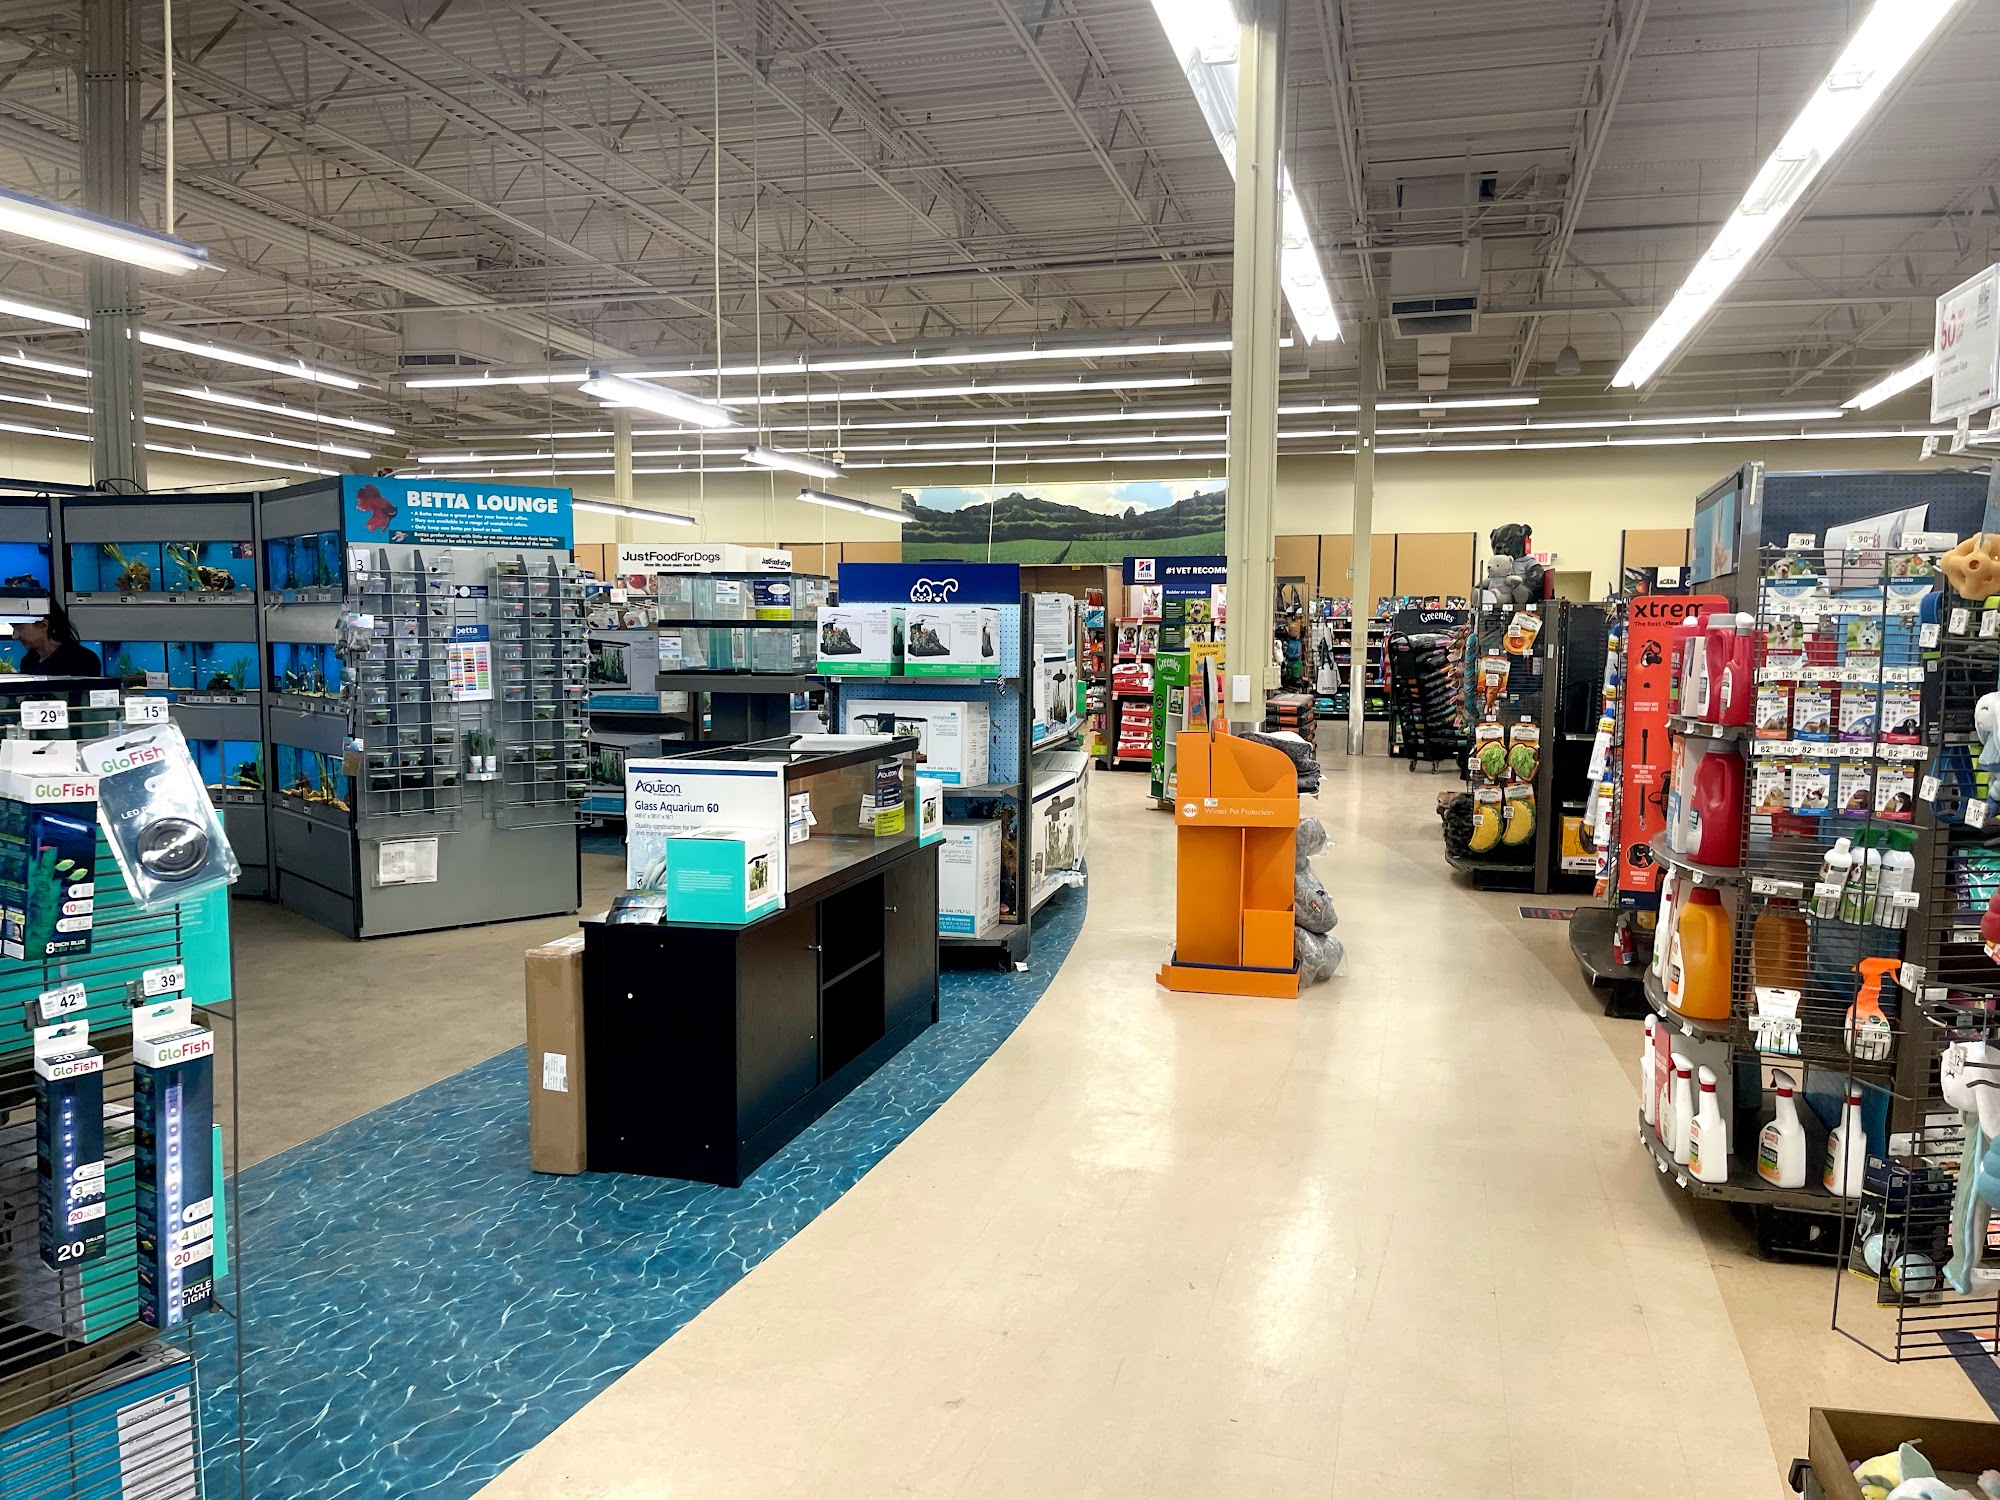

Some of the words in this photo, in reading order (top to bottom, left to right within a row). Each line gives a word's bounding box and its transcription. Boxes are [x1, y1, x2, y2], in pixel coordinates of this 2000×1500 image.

[406, 490, 470, 509] BETTA
[476, 494, 558, 514] LOUNGE
[622, 552, 720, 563] JustFoodForDogs
[357, 560, 364, 570] 3
[1420, 610, 1455, 624] Greenies
[1156, 657, 1181, 672] Greenies
[102, 747, 165, 773] GloFish
[35, 783, 95, 797] GloFish
[121, 808, 139, 819] LED
[635, 800, 657, 810] Glass
[660, 802, 704, 813] Aquarium
[707, 803, 719, 812] 60
[65, 904, 76, 913] 10
[46, 942, 55, 954] 8
[158, 1040, 211, 1061] GloFish
[53, 1060, 98, 1077] GloFish
[75, 1187, 83, 1196] 3
[71, 1211, 83, 1221] 20
[182, 1231, 189, 1241] 4
[57, 1241, 84, 1262] 20
[86, 1234, 104, 1243] GALLON
[174, 1251, 190, 1266] 20
[182, 1279, 212, 1298] CYCLE
[183, 1288, 211, 1307] LIGHT
